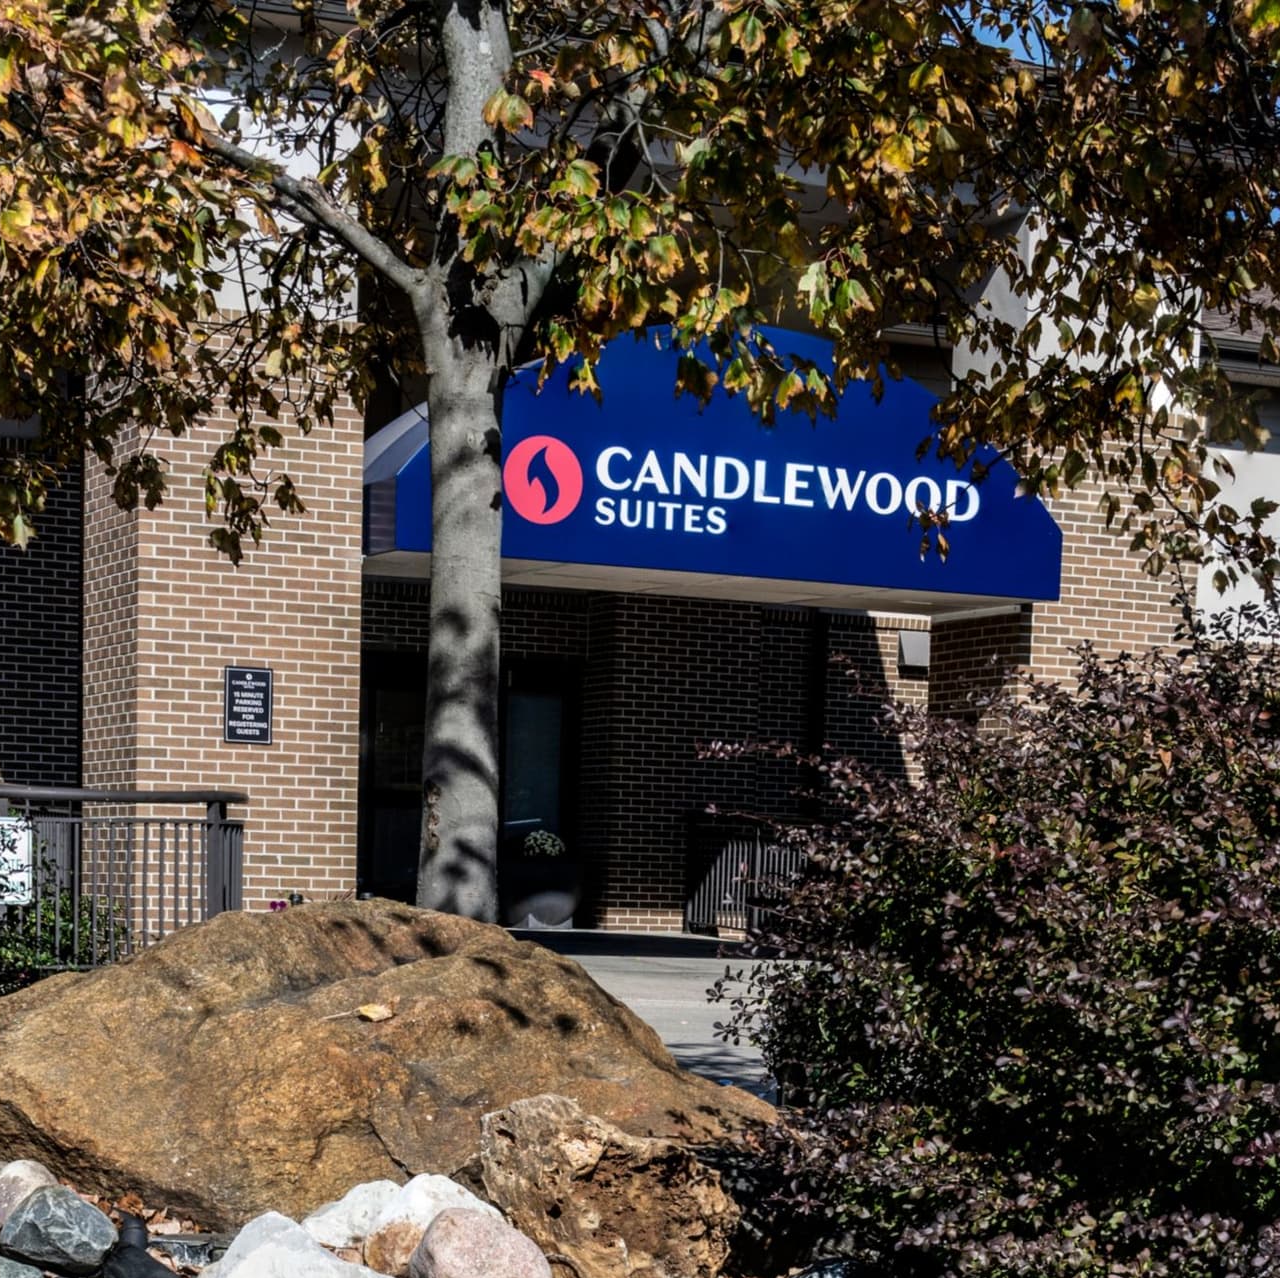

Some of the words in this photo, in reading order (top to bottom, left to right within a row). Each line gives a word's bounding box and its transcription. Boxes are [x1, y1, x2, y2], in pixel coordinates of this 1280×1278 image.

[594, 445, 981, 523] CANDLEWOOD
[594, 497, 728, 535] SUITES
[241, 691, 264, 699] MINUTE
[228, 720, 268, 729] REGISTERING
[236, 728, 260, 736] GUESTS
